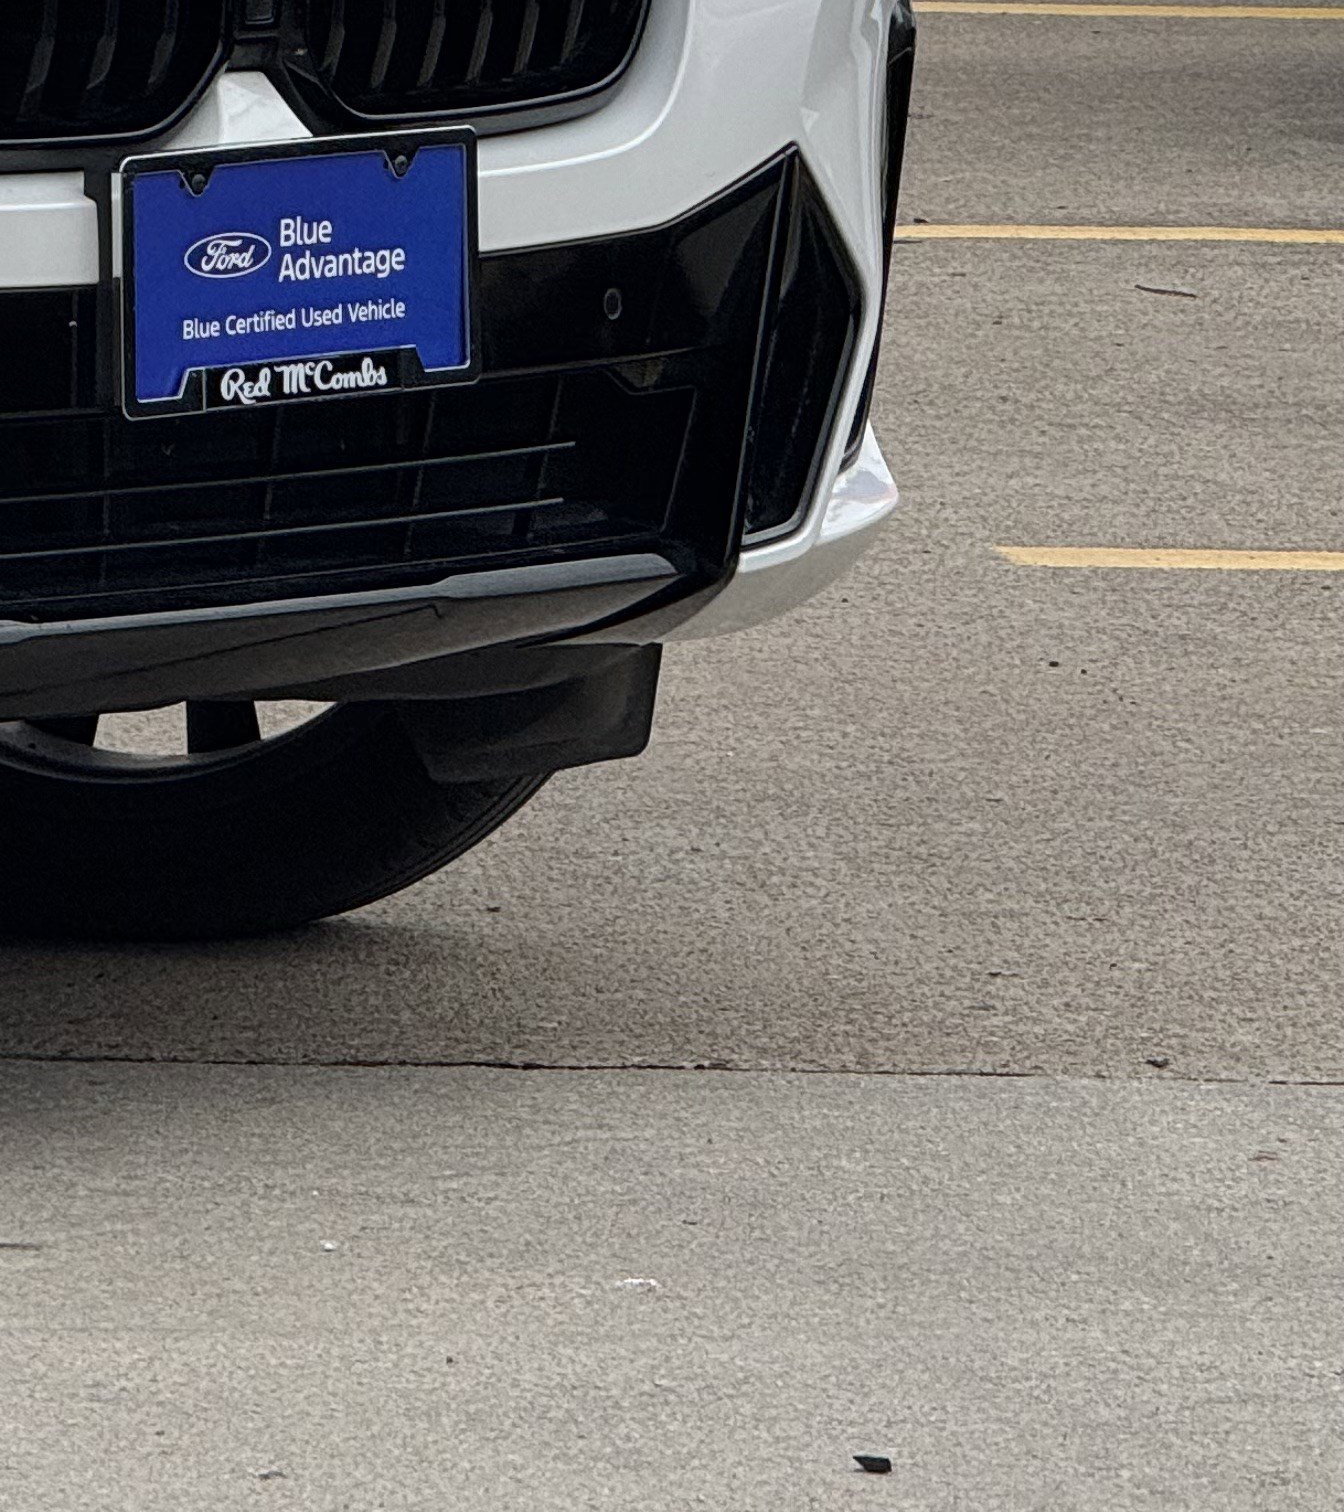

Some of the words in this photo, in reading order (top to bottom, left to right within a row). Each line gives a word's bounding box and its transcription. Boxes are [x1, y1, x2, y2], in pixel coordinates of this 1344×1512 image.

[278, 216, 333, 247] Blue
[199, 238, 256, 273] Ford
[278, 247, 406, 283] Advantage
[182, 318, 221, 340] Blue
[224, 308, 297, 336] Certified
[300, 303, 343, 328] Used
[347, 297, 407, 323] Vehicle
[220, 368, 272, 405] Red
[273, 357, 389, 394] McCombs
